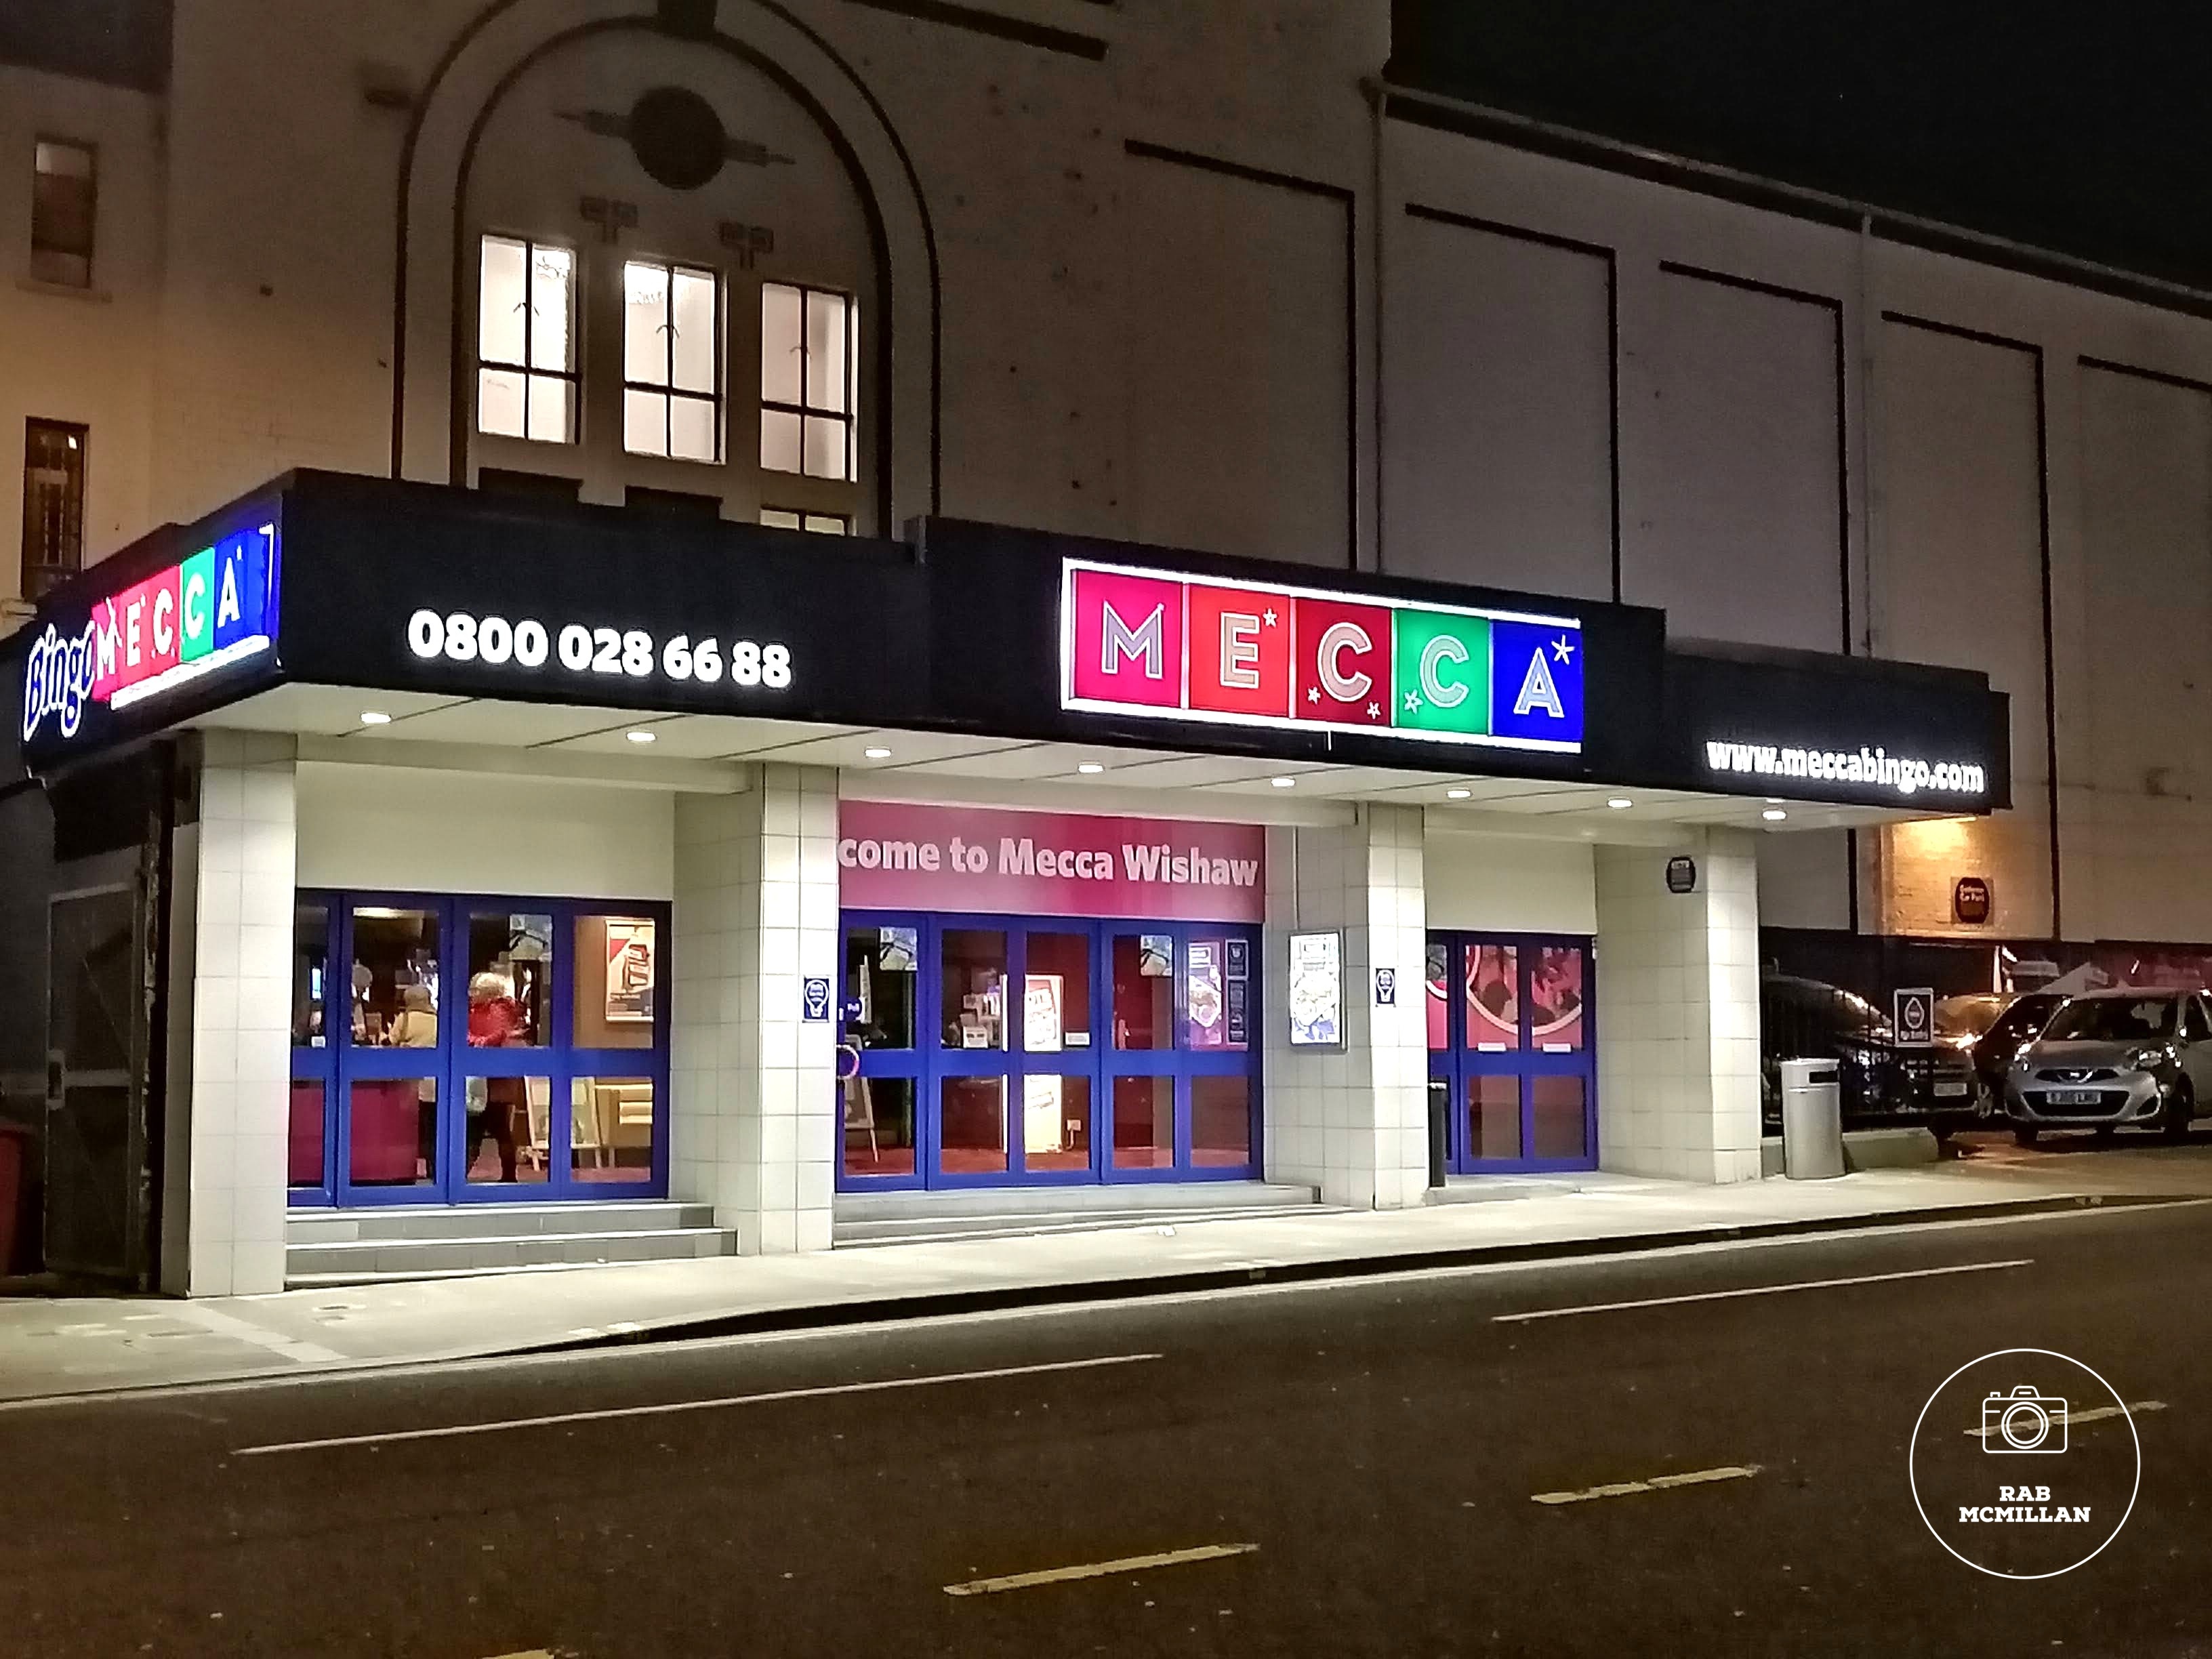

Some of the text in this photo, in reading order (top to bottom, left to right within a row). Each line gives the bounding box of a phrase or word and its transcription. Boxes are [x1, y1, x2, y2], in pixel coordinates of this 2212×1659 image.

[23, 556, 241, 742] Bingo MECCA
[407, 610, 792, 689] 0800 028 66 88
[1101, 598, 1565, 718] MECCA
[1706, 741, 1985, 793] www.meccabingo.com
[949, 837, 989, 874] to
[998, 838, 1113, 880] Mecca
[1122, 844, 1258, 886] Wishaw
